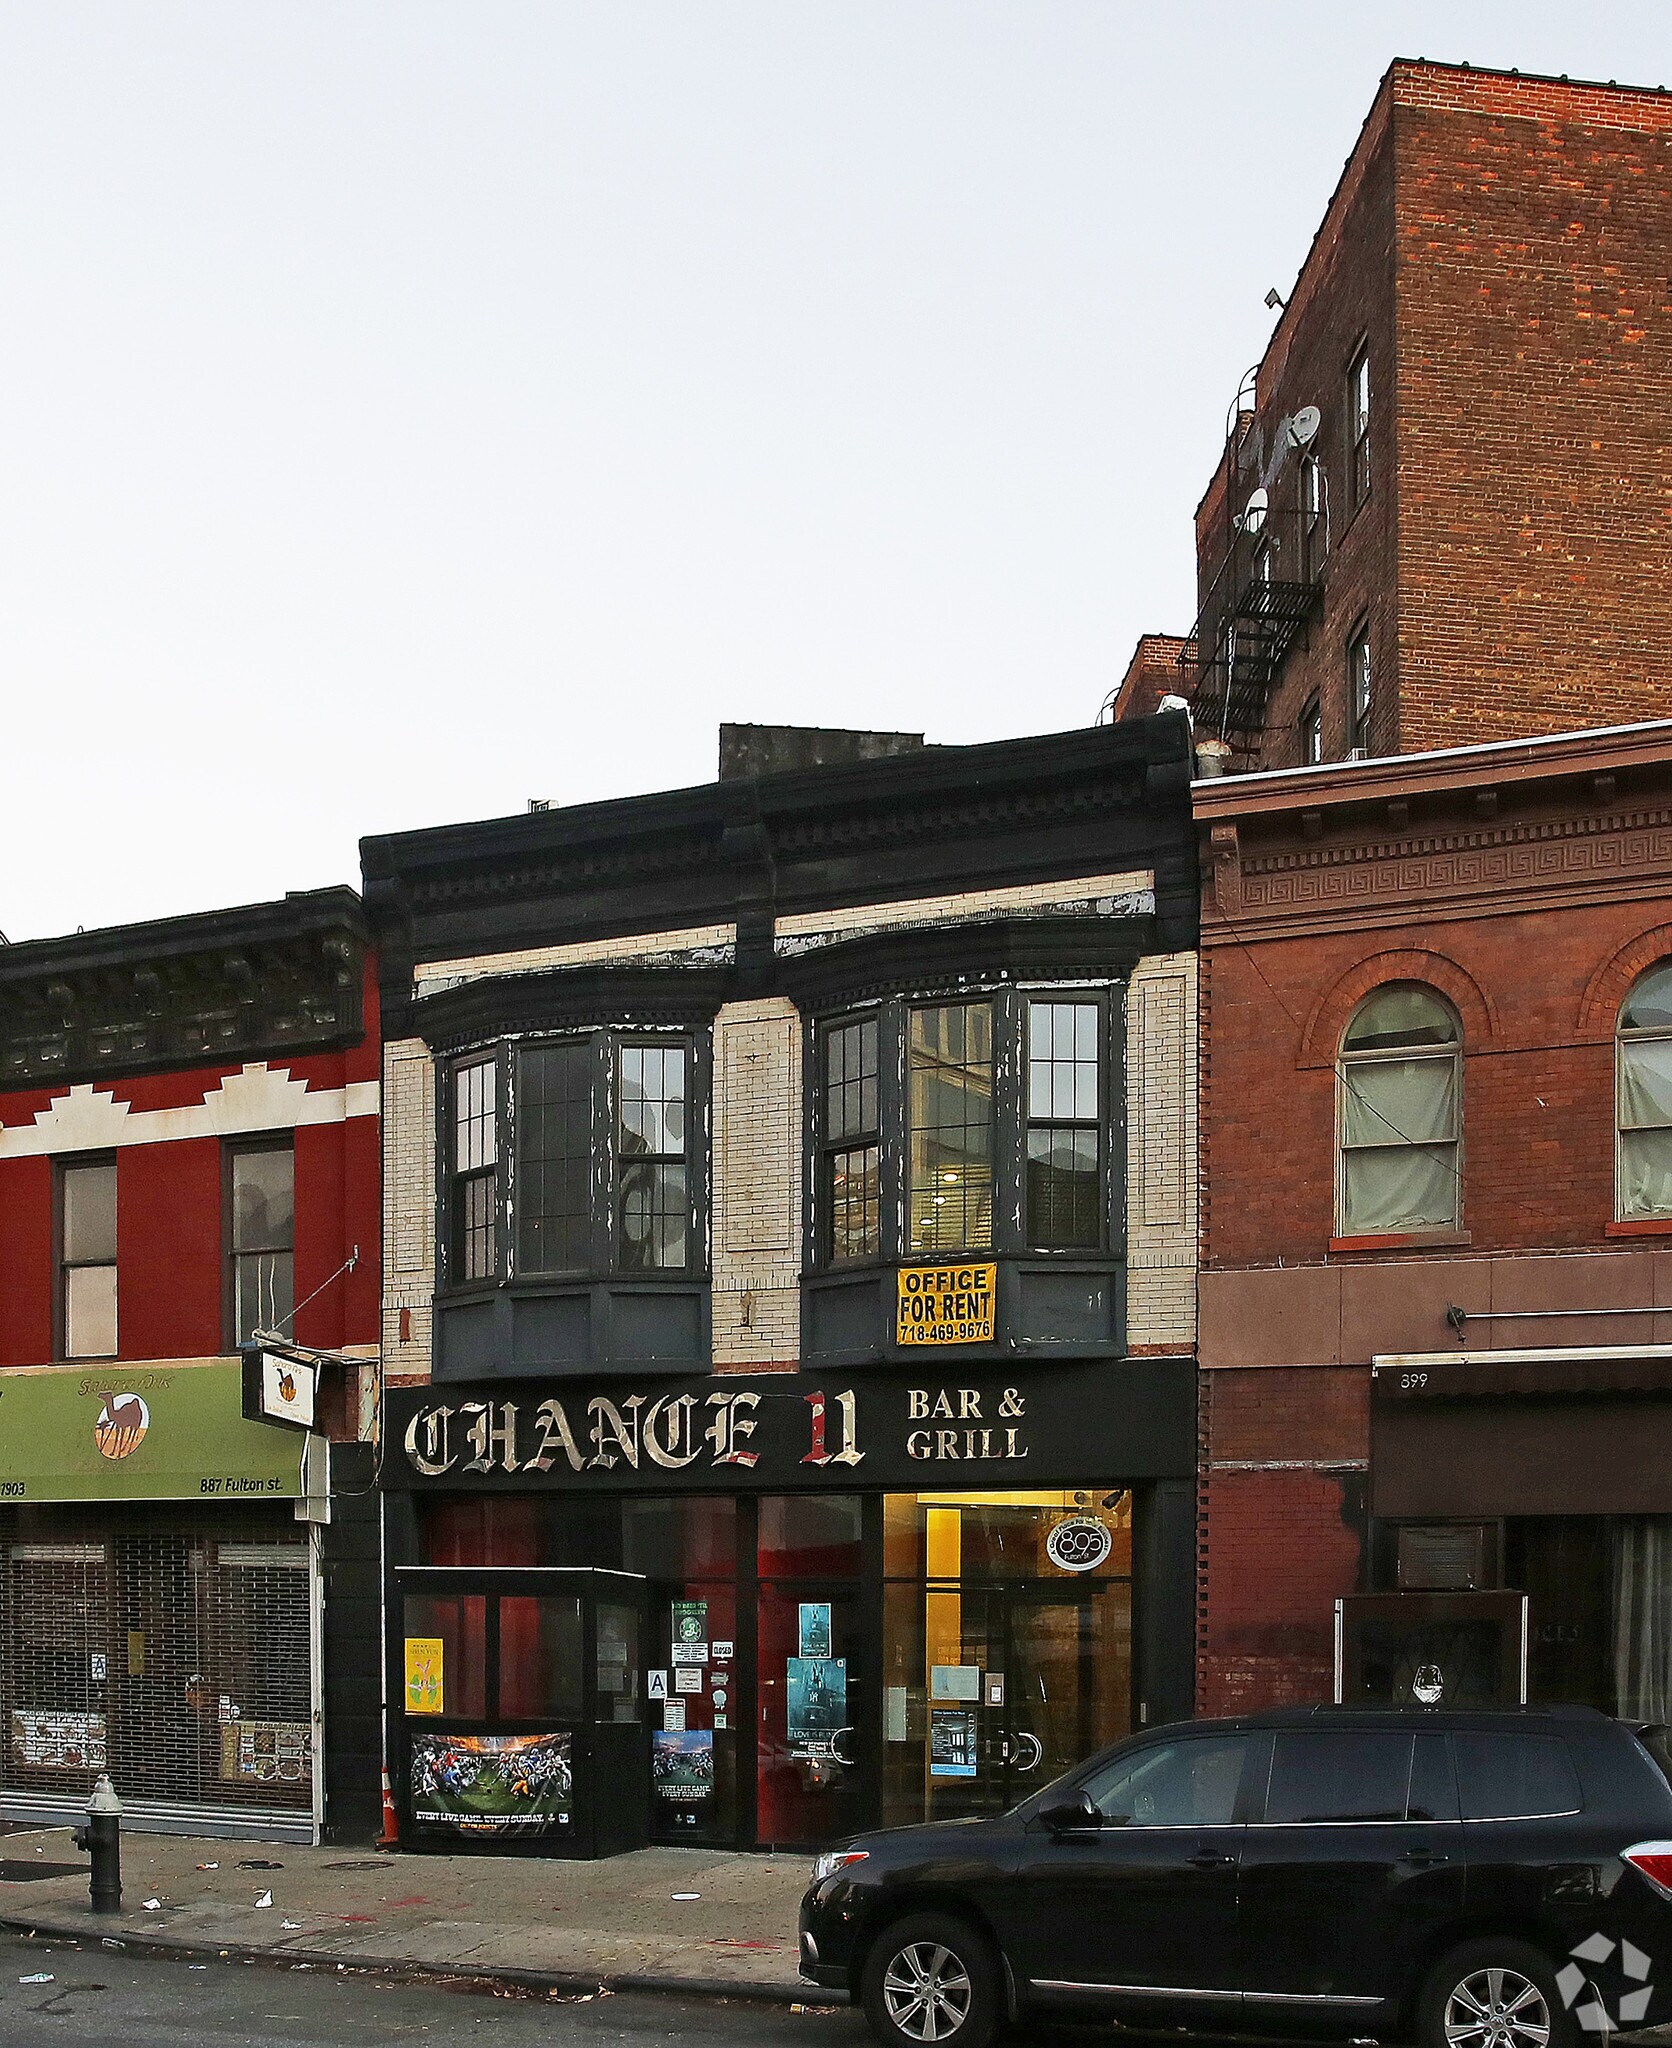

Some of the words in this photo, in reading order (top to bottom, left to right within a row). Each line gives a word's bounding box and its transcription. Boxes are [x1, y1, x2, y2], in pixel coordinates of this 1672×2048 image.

[905, 1269, 987, 1293] OFFICE
[900, 1295, 936, 1323] FOR
[942, 1292, 991, 1321] RENT
[900, 1320, 991, 1341] 718-469-9676
[1400, 1372, 1429, 1389] 899
[907, 1388, 983, 1420] BAR
[998, 1387, 1026, 1418] &
[404, 1393, 762, 1476] CHANCE
[906, 1427, 1029, 1460] GRILL
[0, 1482, 25, 1496] 1903
[200, 1477, 223, 1493] 887
[225, 1477, 264, 1492] Fulton
[266, 1476, 284, 1491] st.
[1059, 1530, 1102, 1556] 895
[713, 1646, 732, 1655] CLOSED
[651, 1673, 664, 1691] A
[416, 1811, 440, 1820] EVERY
[441, 1812, 459, 1822] LIVE
[484, 1815, 510, 1823] EVERY
